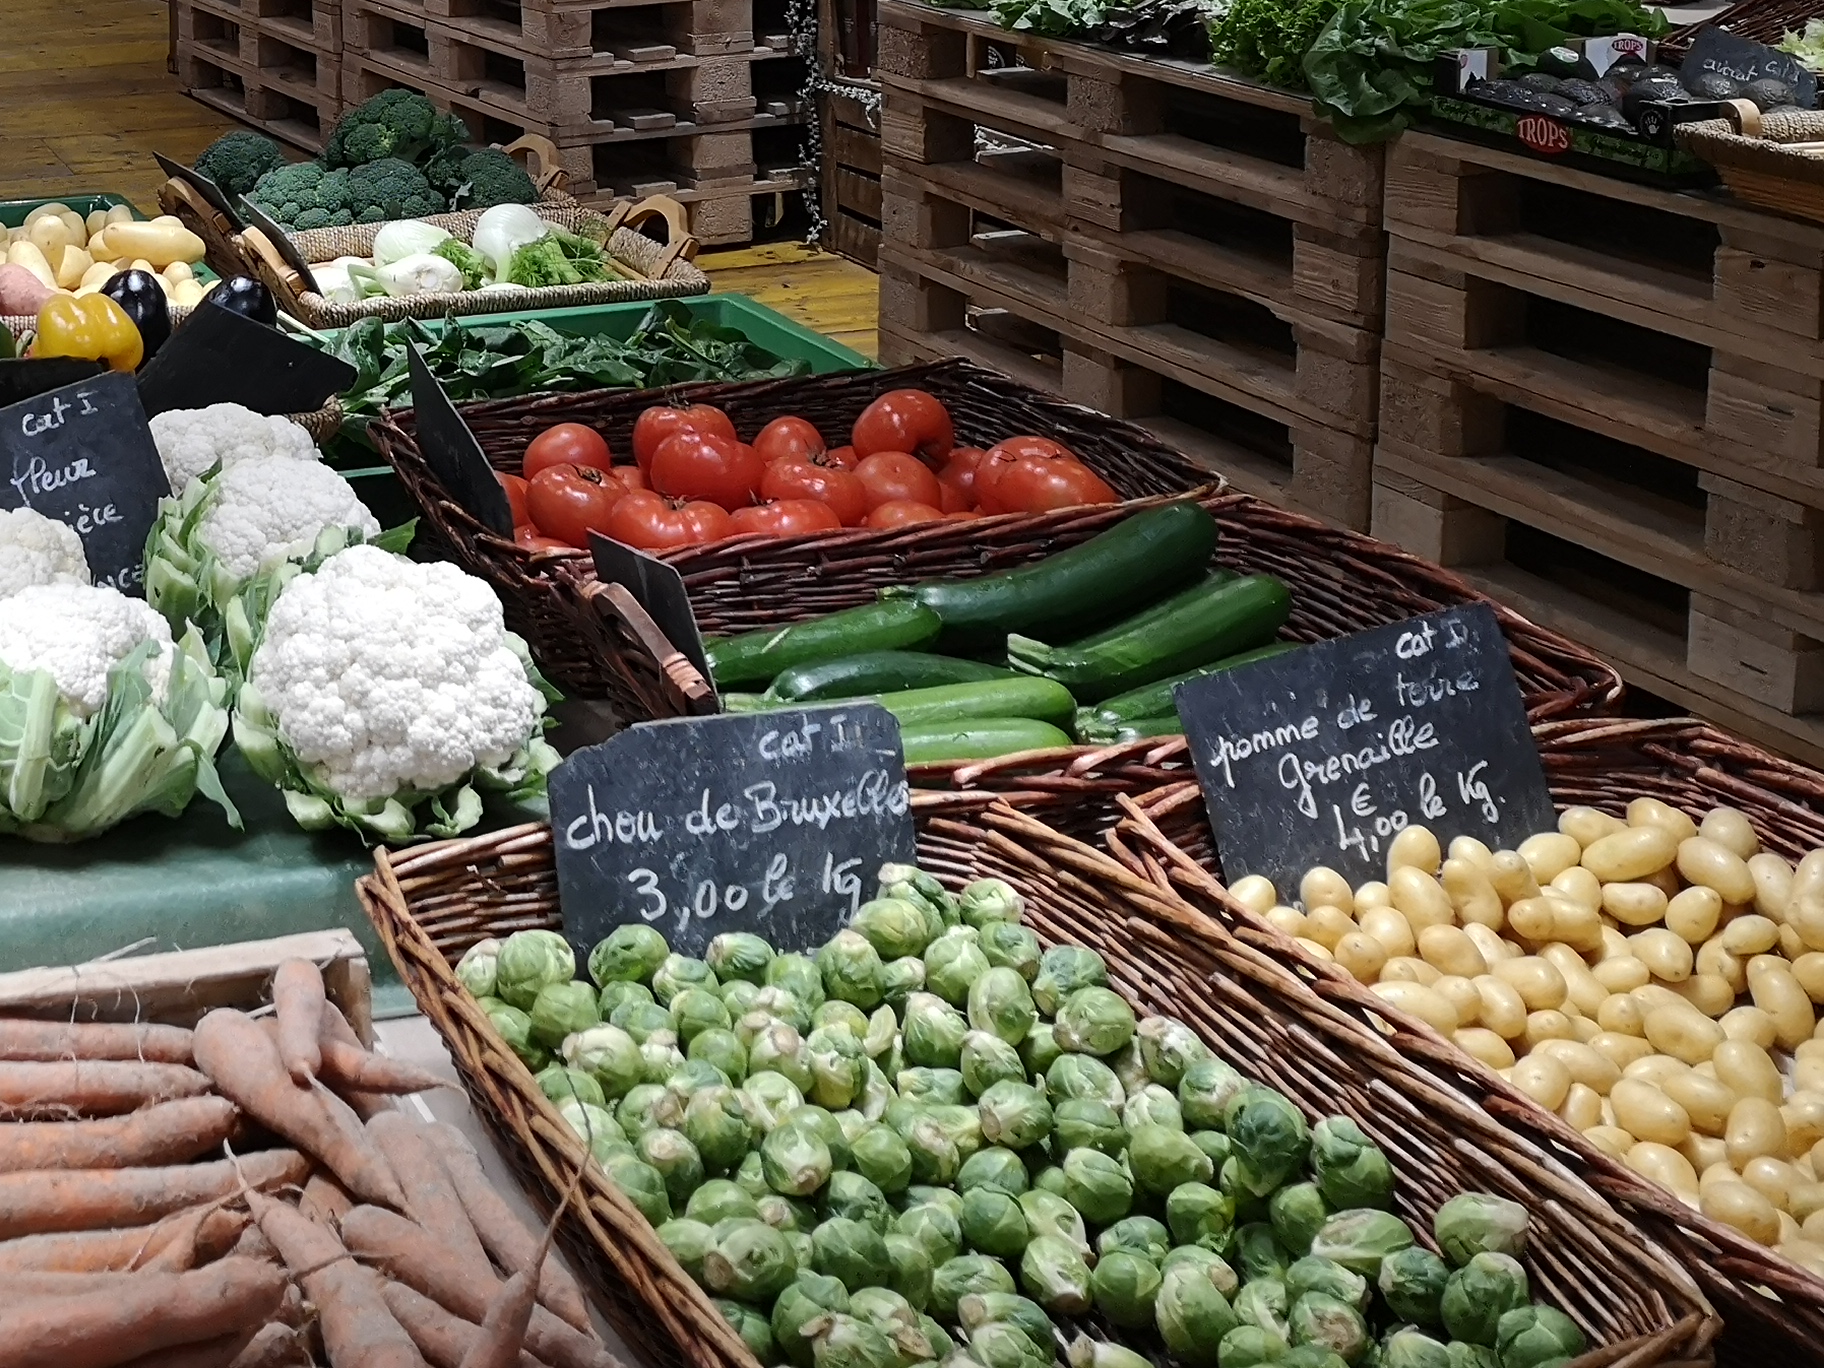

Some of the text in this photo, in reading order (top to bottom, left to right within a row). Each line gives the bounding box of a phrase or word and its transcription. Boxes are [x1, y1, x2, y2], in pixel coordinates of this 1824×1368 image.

[1614, 40, 1644, 51] TROPS
[1517, 116, 1569, 150] TROPS
[76, 390, 100, 417] I
[63, 502, 125, 536] ièce
[1210, 693, 1376, 787] pomme de
[565, 784, 664, 851] chou
[684, 786, 741, 839] de
[1335, 802, 1412, 862] 4,00
[1419, 772, 1449, 821] le
[1349, 784, 1372, 818] €
[627, 868, 749, 933] 3,00
[761, 856, 797, 908] le
